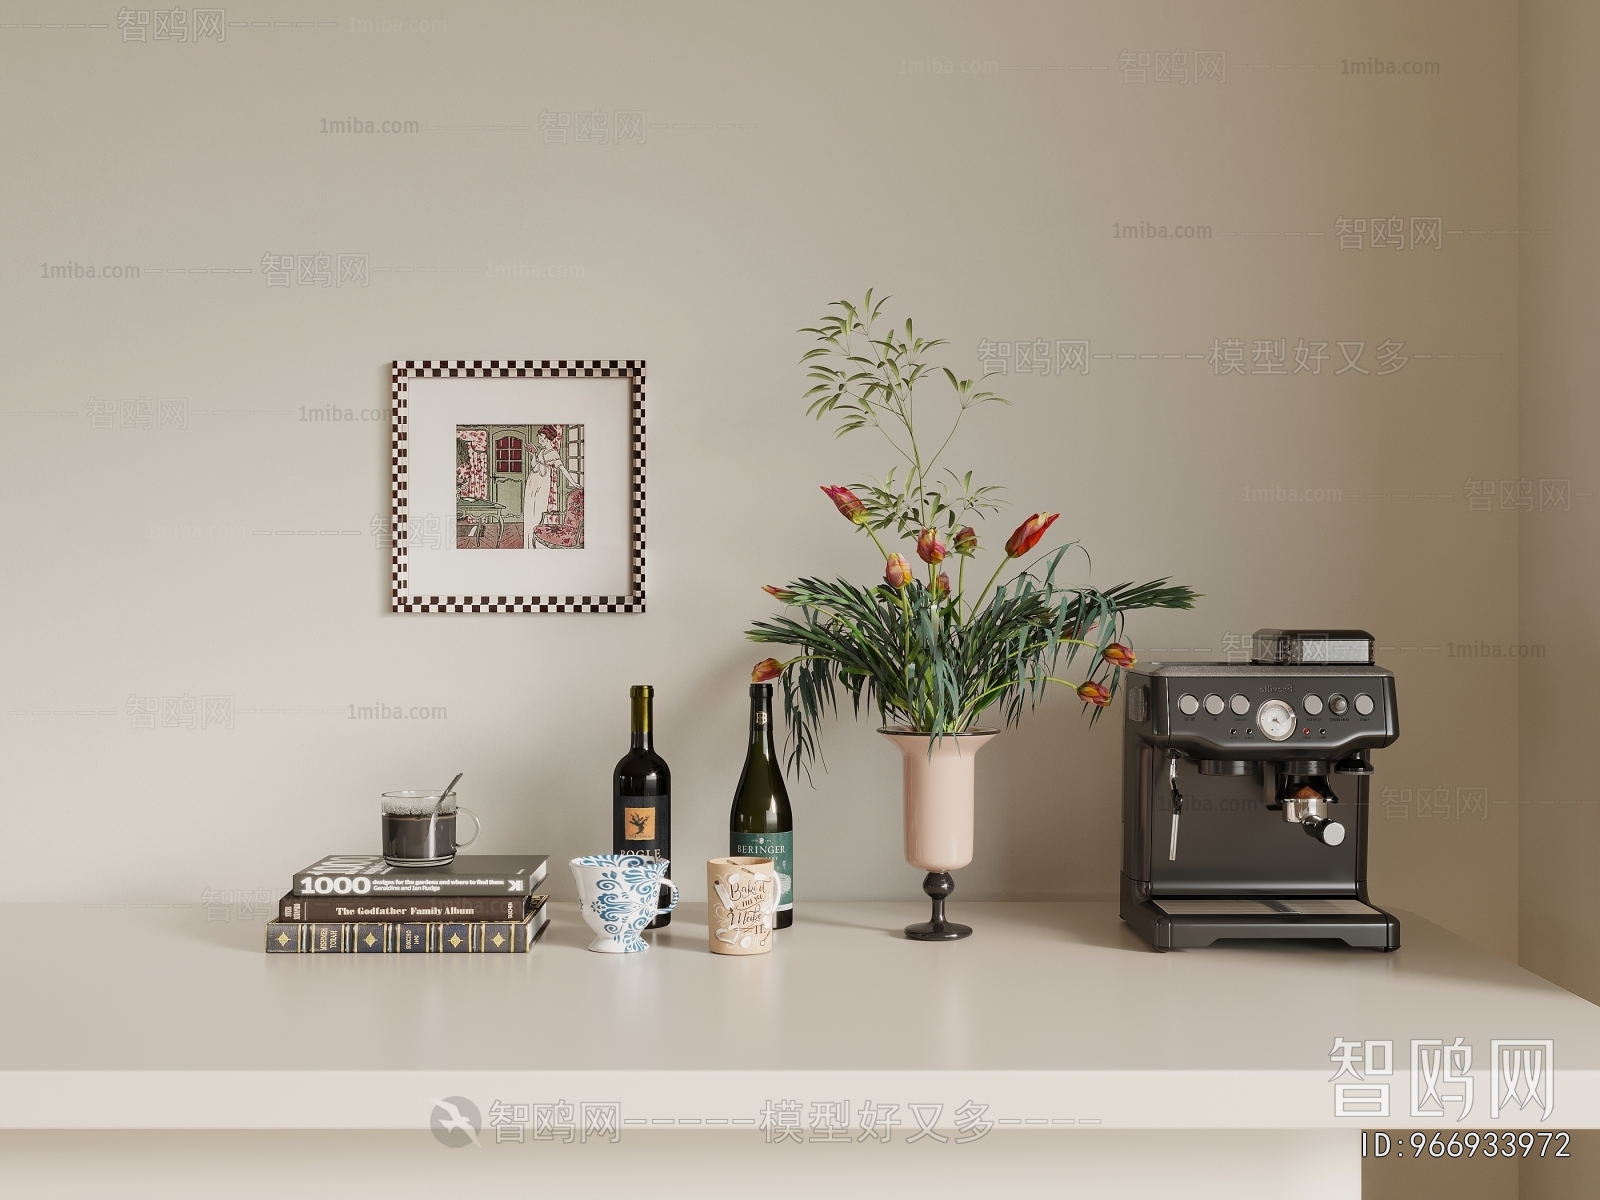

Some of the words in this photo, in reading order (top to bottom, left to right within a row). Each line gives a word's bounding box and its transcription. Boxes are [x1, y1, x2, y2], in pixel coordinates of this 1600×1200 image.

[737, 844, 786, 854] BERINGER
[300, 876, 371, 895] 1000
[729, 880, 757, 901] Bake
[336, 907, 355, 916] The
[357, 906, 407, 916] Godfather
[410, 906, 442, 917] Family
[444, 906, 475, 916] Album
